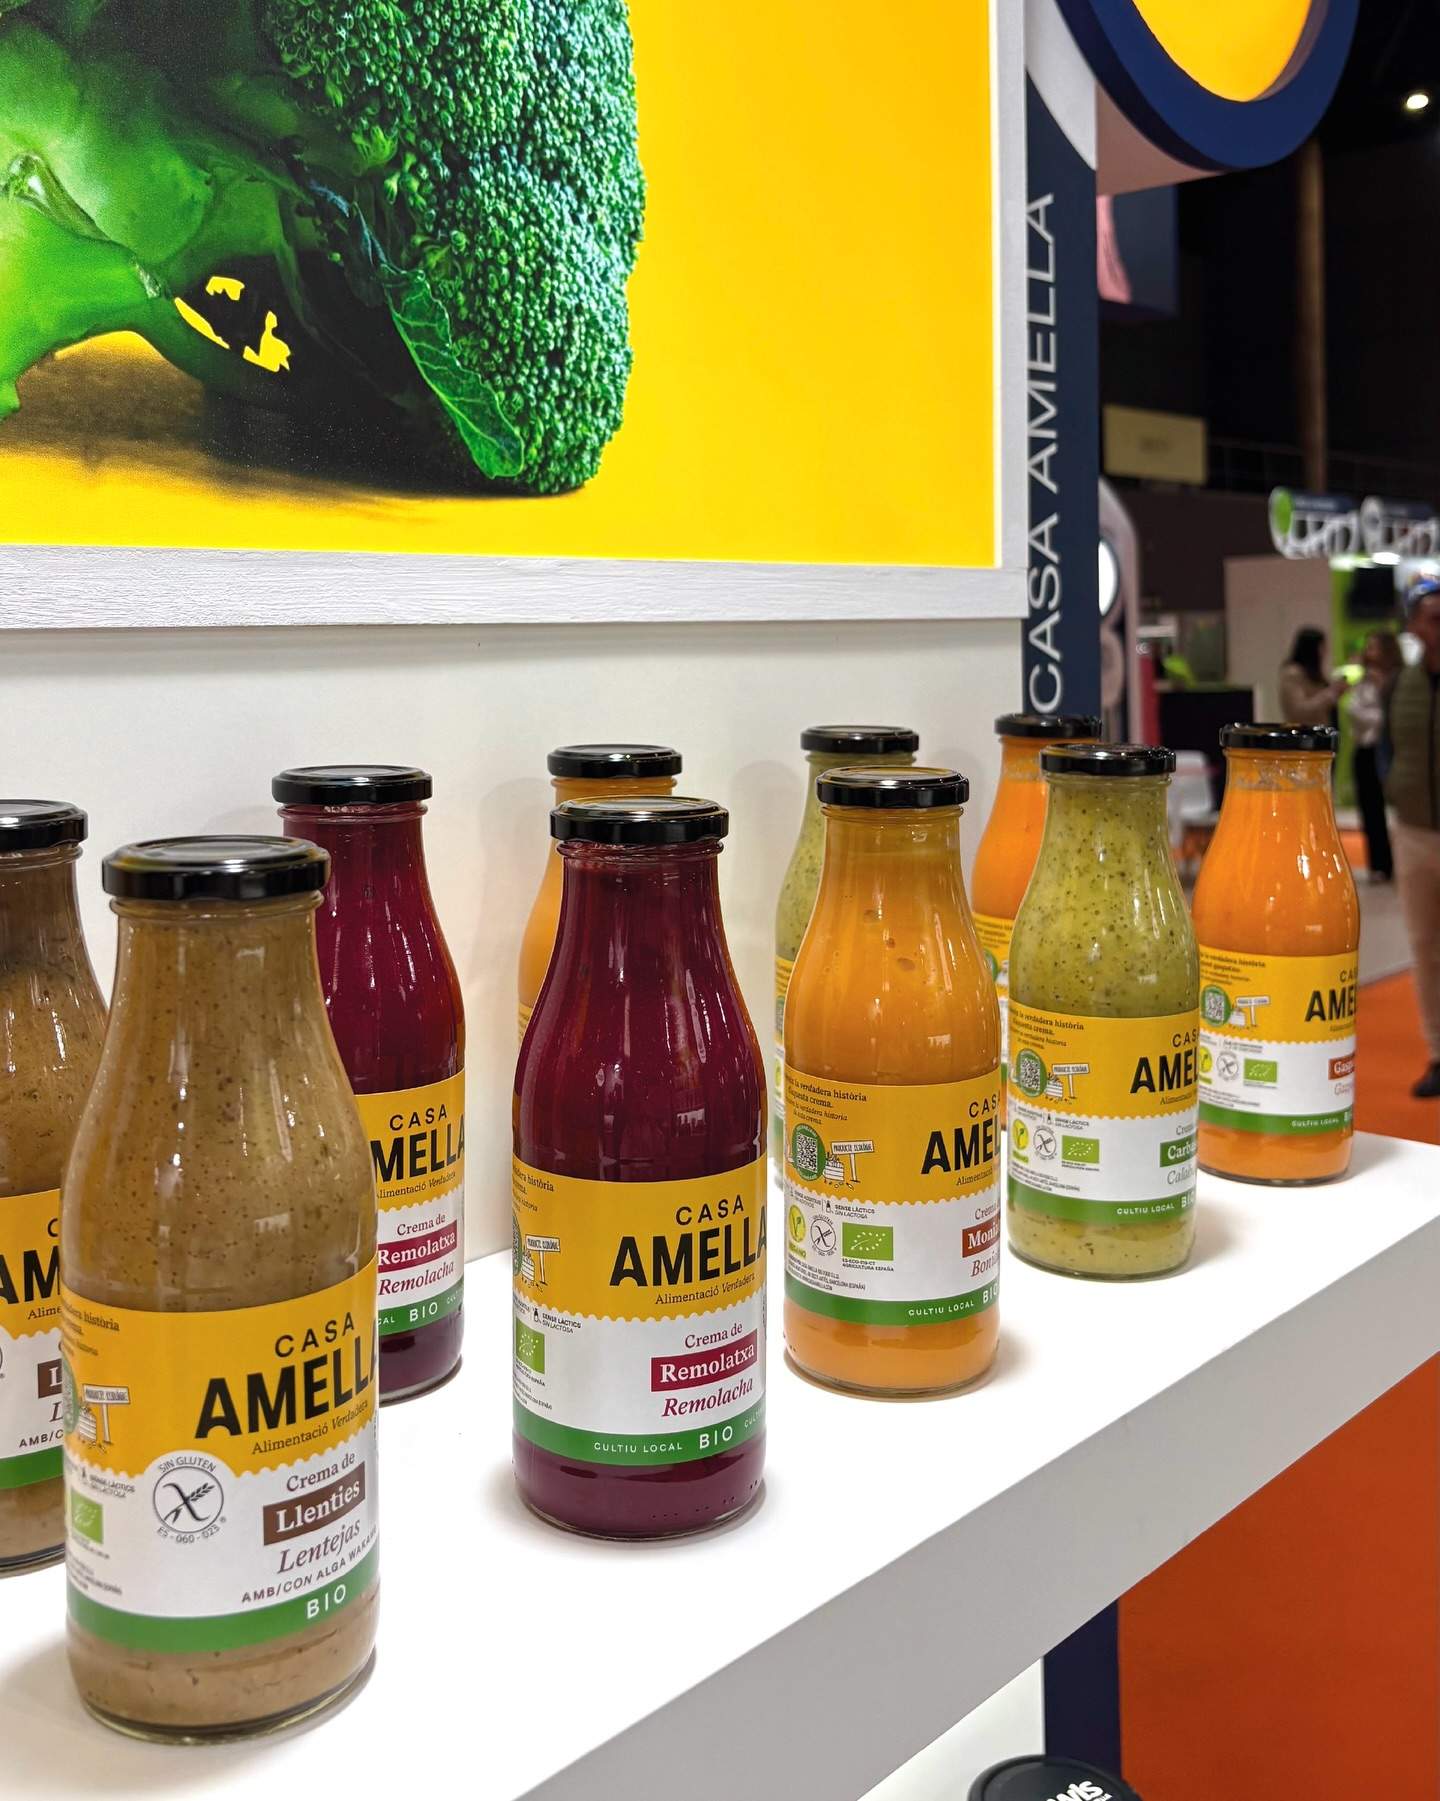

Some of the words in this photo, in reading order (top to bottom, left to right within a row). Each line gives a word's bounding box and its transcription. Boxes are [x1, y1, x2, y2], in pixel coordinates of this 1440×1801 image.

[1027, 193, 1058, 494] AMELLA
[1029, 511, 1062, 714] CASA
[389, 1103, 448, 1132] CASA
[397, 1219, 434, 1236] Crema
[435, 1213, 446, 1226] de
[676, 1194, 745, 1226] CASA
[1151, 1203, 1175, 1213] LOCAL
[378, 1231, 455, 1266] Remolatxa
[378, 1260, 454, 1296] Remolacha
[655, 1285, 720, 1305] Alimentació
[908, 1307, 944, 1317] CULTIU
[948, 1300, 975, 1312] LOCAL
[409, 1302, 438, 1322] BIO
[550, 1322, 574, 1334] LACTOSA
[275, 1311, 355, 1358] CASA
[684, 1330, 729, 1349] Crema
[730, 1323, 743, 1338] de
[660, 1343, 755, 1384] Remolatxa
[662, 1377, 754, 1418] Remolacha
[252, 1423, 329, 1455] Alimentació
[594, 1441, 637, 1454] CULTIU
[643, 1442, 683, 1454] LOCAL
[700, 1425, 733, 1449] BIO
[158, 1458, 175, 1474] SIN
[176, 1455, 217, 1473] GLUTEN
[286, 1463, 339, 1492] Crema
[341, 1452, 356, 1469] de
[276, 1480, 360, 1533] Llenties
[276, 1519, 361, 1575] Lentejas
[241, 1574, 313, 1603] AMB/CON
[316, 1557, 346, 1581] ALGA
[307, 1584, 347, 1620] BIO
